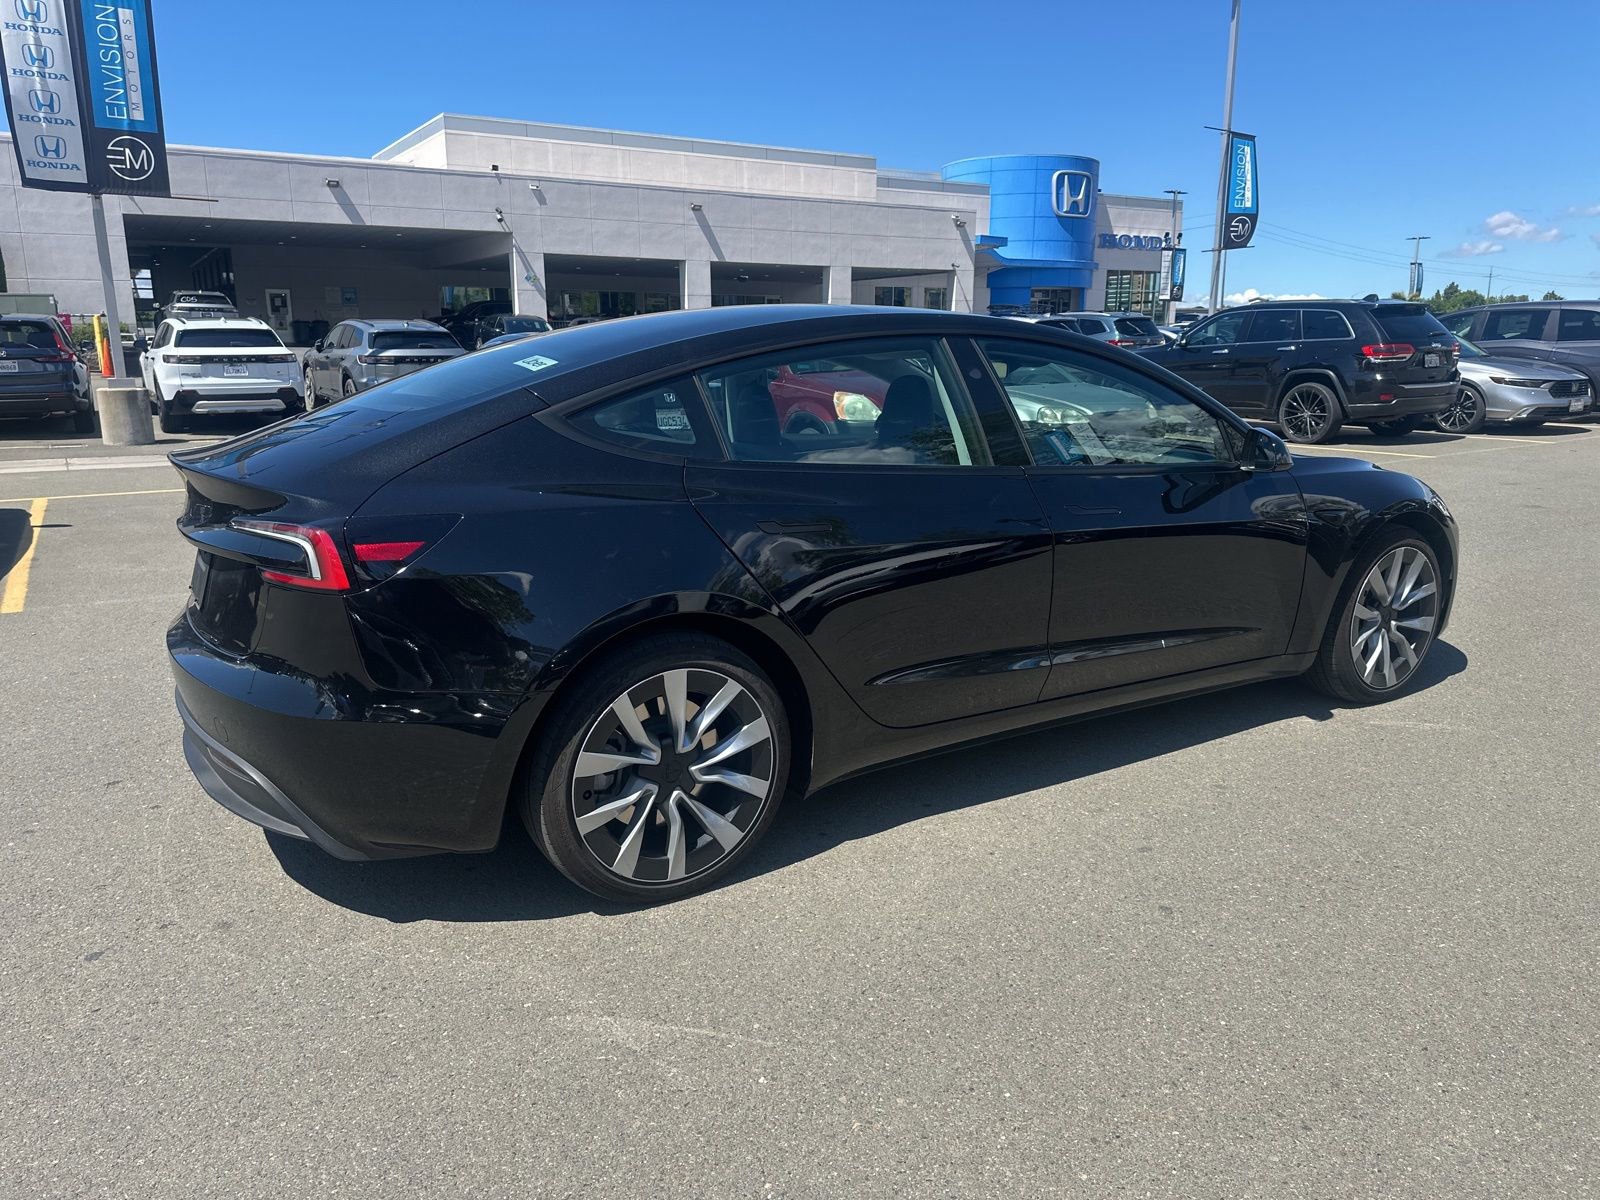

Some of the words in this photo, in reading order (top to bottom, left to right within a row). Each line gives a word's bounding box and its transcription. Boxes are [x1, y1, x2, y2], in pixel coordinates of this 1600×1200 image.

[4, 22, 64, 36] HONDA
[94, 4, 127, 119] ENVISION
[122, 18, 140, 111] MOTORS
[11, 67, 70, 82] HONDA
[17, 113, 76, 127] HONDA
[26, 159, 81, 171] HONDA
[1234, 144, 1247, 207] ENVISION
[1097, 233, 1171, 251] HOND
